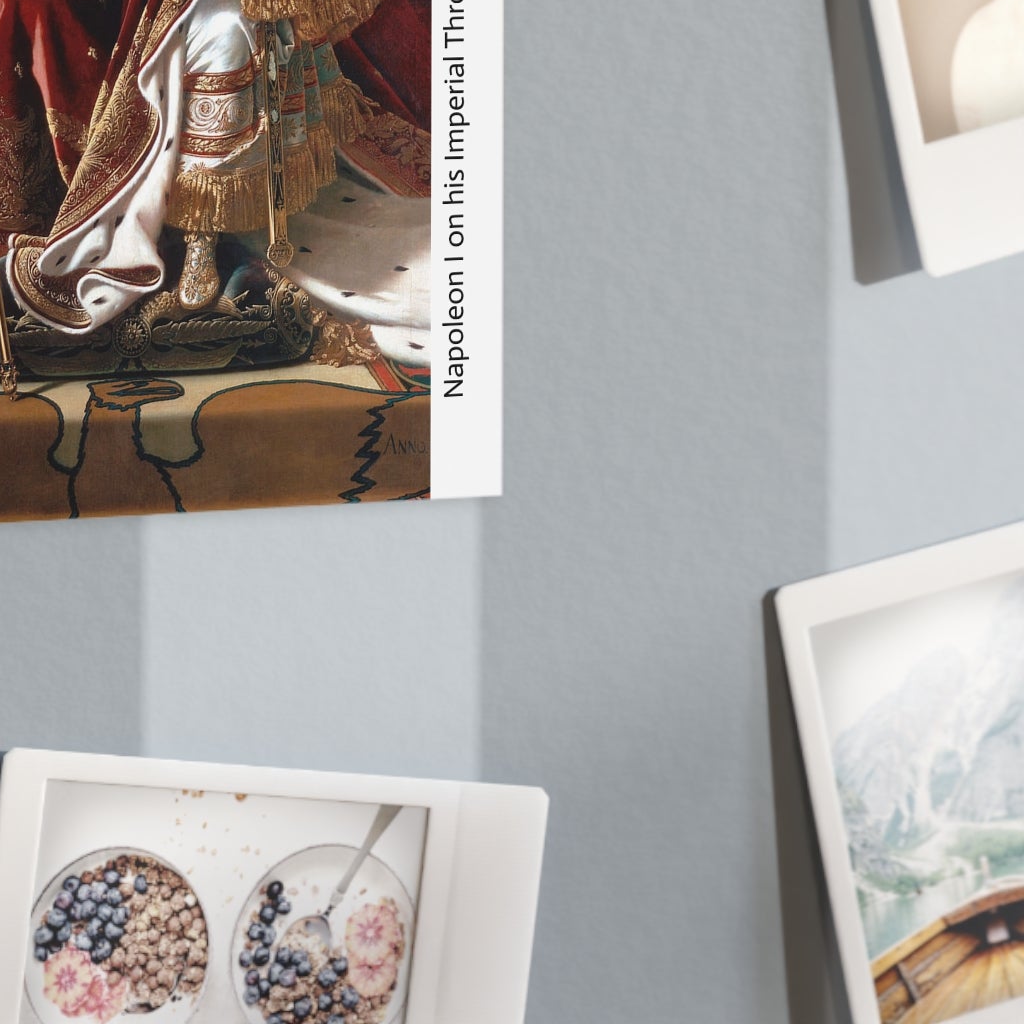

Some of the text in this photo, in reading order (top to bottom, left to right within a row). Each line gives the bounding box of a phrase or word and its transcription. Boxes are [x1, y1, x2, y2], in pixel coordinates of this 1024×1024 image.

[442, 56, 471, 159] Imperial
[442, 169, 464, 204] his
[448, 214, 464, 247] on
[442, 271, 470, 397] Napoleon
